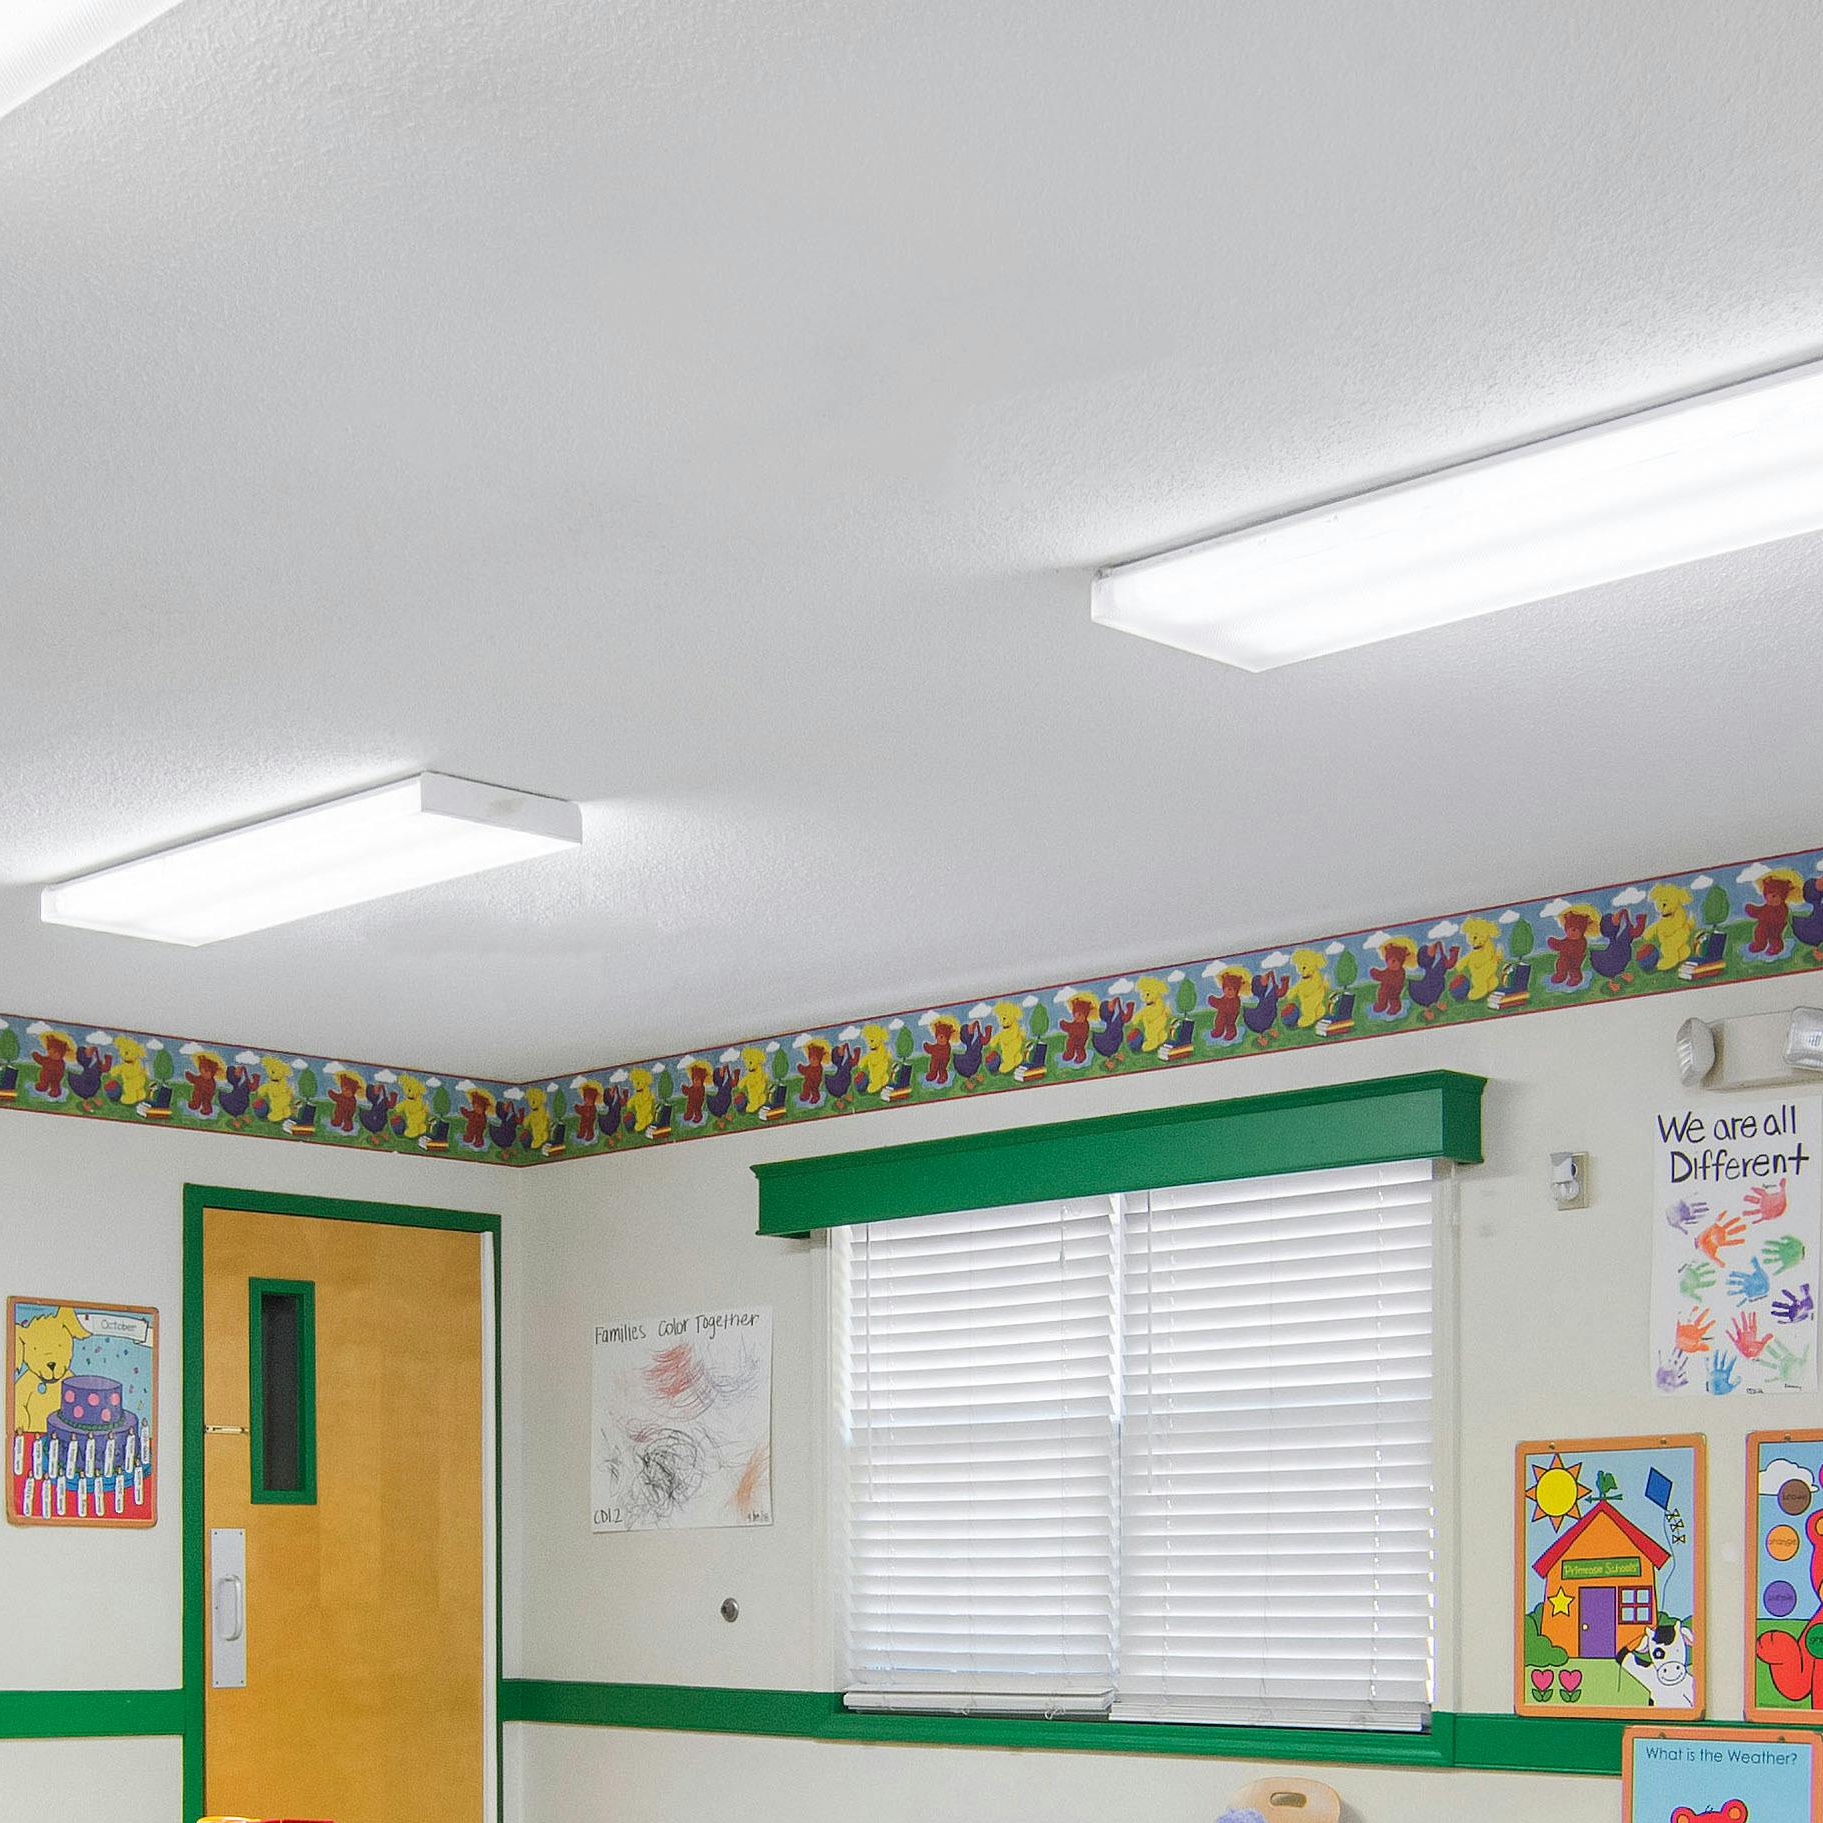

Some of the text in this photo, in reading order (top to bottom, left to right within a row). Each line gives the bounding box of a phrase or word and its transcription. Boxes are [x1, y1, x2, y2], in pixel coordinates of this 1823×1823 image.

[1657, 1103, 1796, 1144] We are all
[1670, 1142, 1810, 1184] Different
[100, 1319, 138, 1332] October
[595, 1313, 760, 1345] Families Color Together
[1782, 1491, 1808, 1501] brown
[1768, 1537, 1797, 1547] orange
[1646, 1747, 1798, 1765] What is the Weather?
